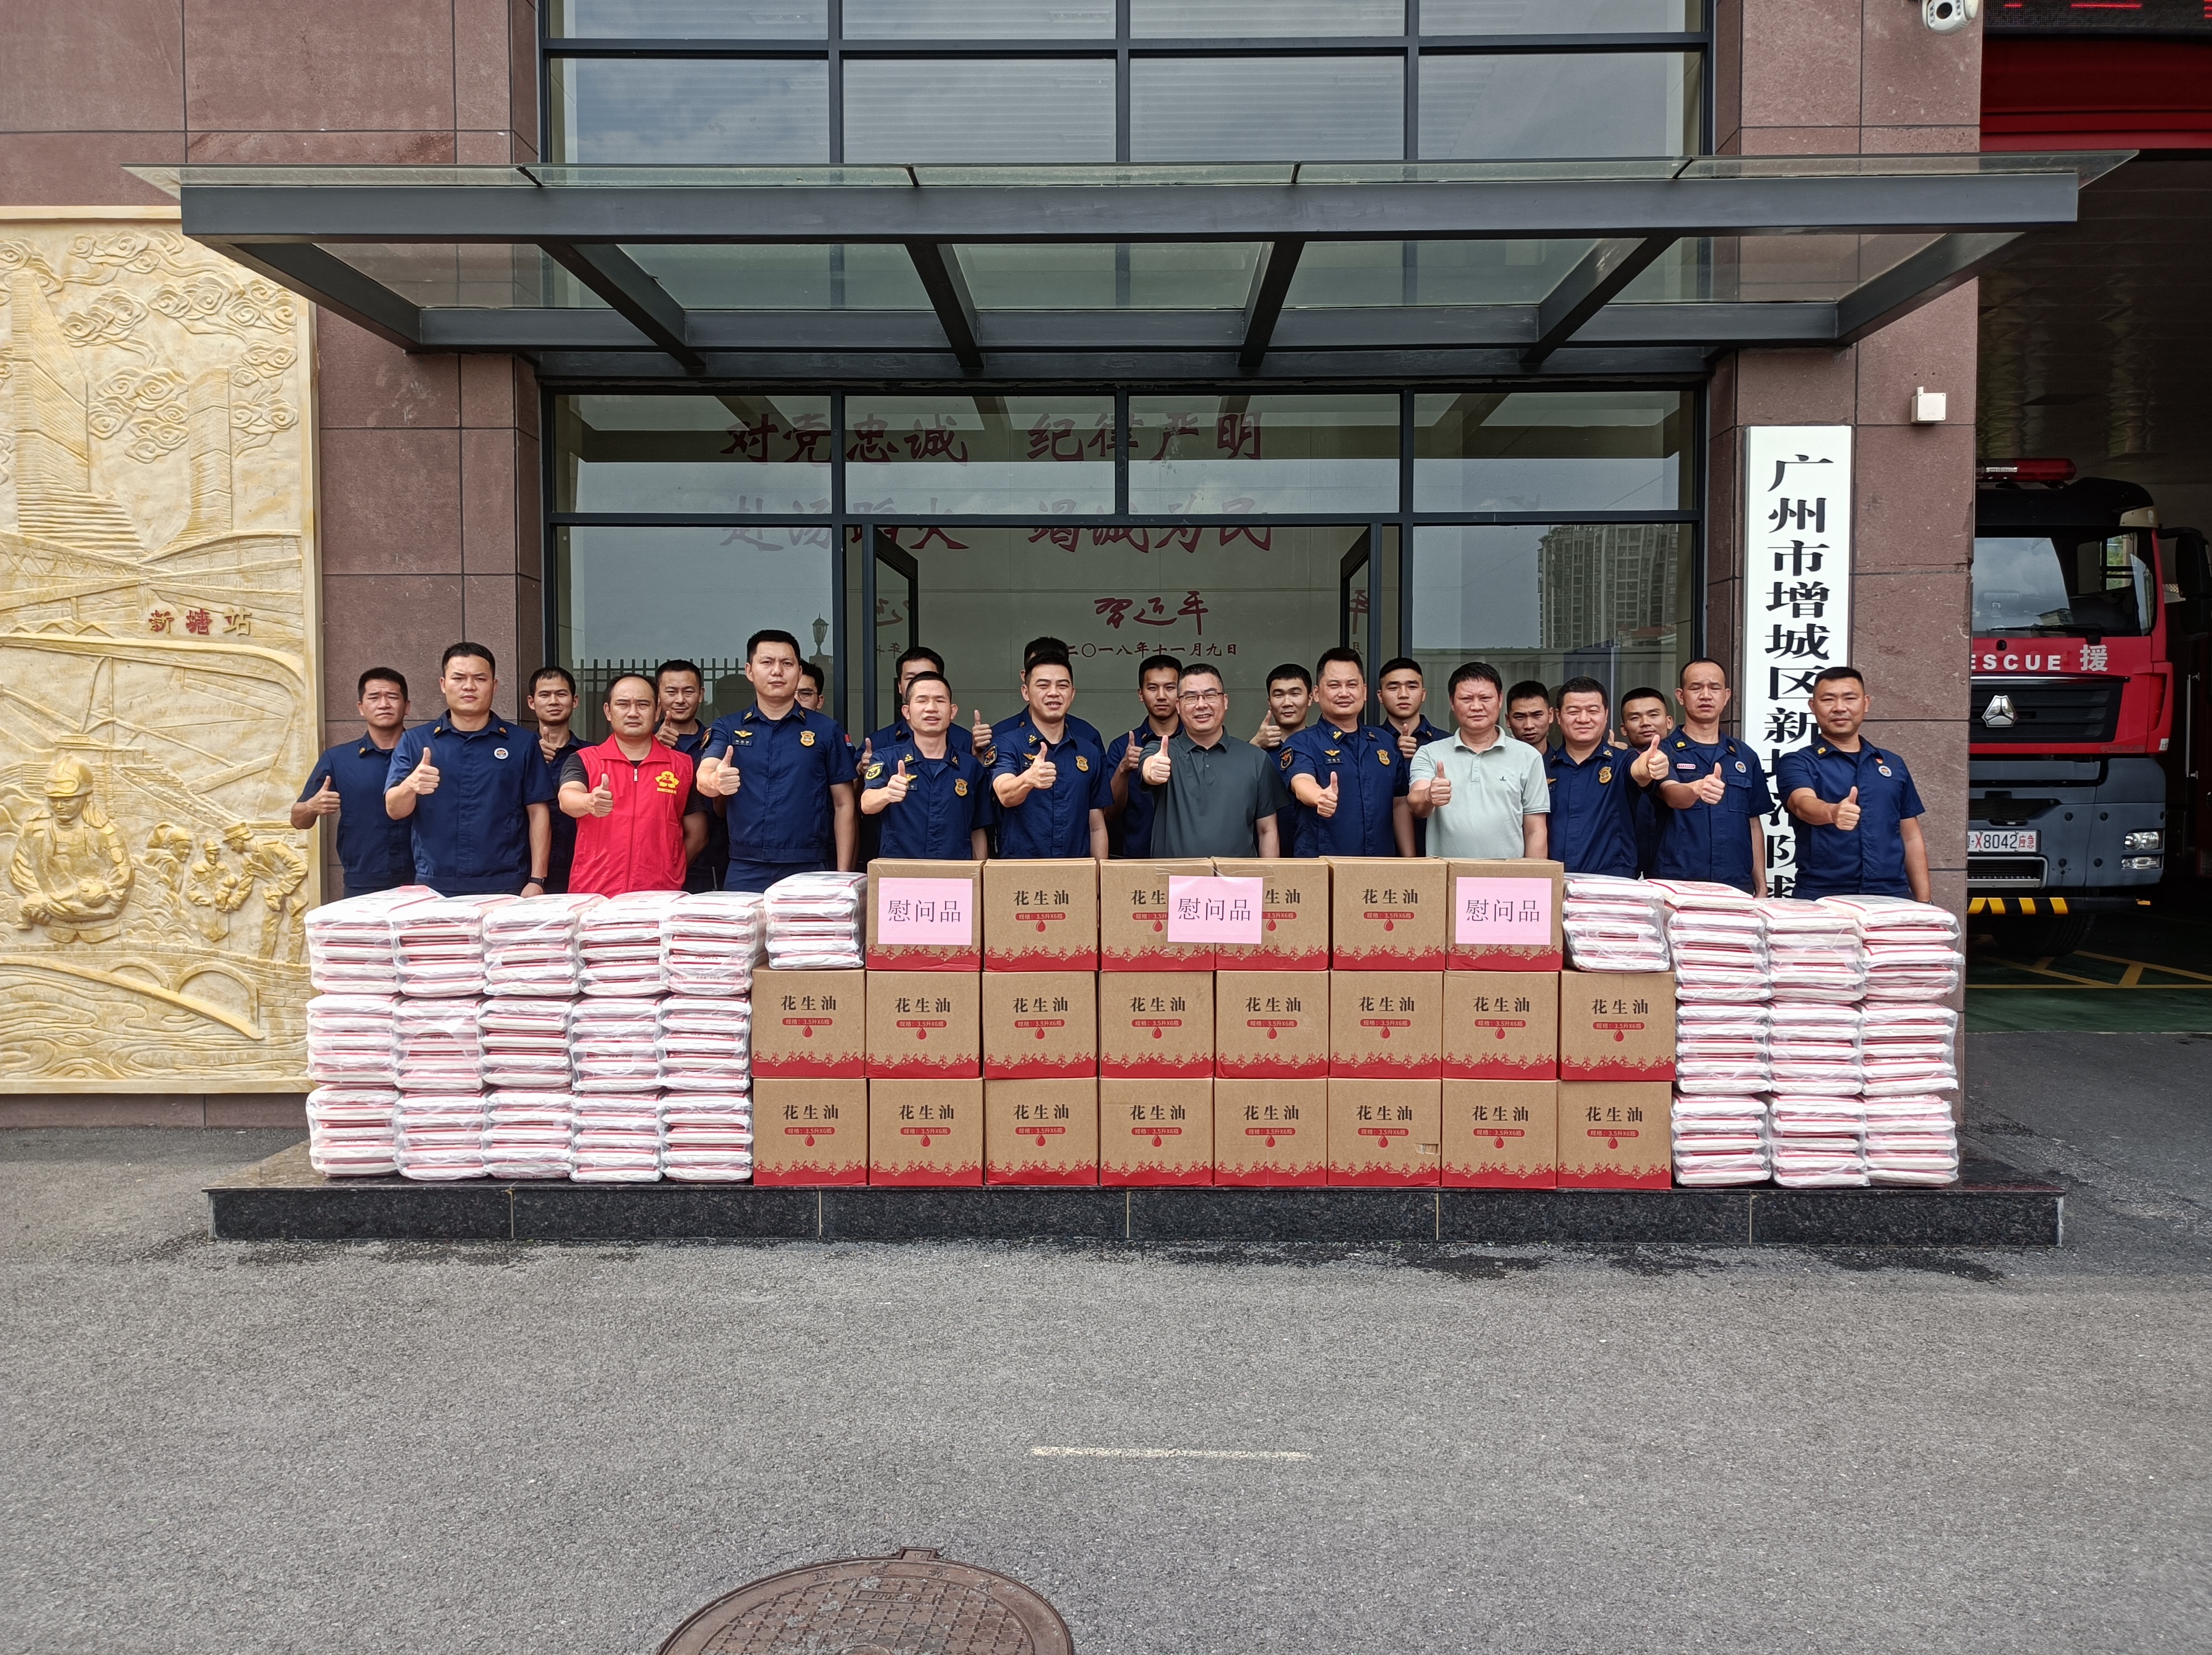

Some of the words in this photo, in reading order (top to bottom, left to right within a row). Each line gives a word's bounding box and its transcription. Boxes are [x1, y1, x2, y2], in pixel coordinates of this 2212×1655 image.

[720, 413, 968, 466] 对党忠诚
[1027, 412, 1262, 464] 纪律严明
[149, 606, 252, 636] 新塘站
[2080, 644, 2107, 672] 援
[1762, 454, 1834, 898] 广州市增城区新防
[1014, 889, 1068, 906] 花生油
[1131, 889, 1166, 905] 花生
[1265, 888, 1300, 904] 生油
[1363, 888, 1417, 904] 花生油
[888, 899, 961, 923] 慰问品
[1177, 898, 1251, 921] 慰问品
[1465, 899, 1540, 923] 慰问品
[781, 995, 836, 1011] 花生油
[895, 997, 950, 1013] 花生油
[1013, 997, 1067, 1013] 花生油
[1130, 996, 1185, 1012] 花生油
[1246, 997, 1300, 1012] 花生油
[1359, 996, 1414, 1012] 花生油
[1474, 996, 1529, 1012] 花生油
[1592, 999, 1647, 1014] 花生油
[783, 1104, 838, 1120] 花生油
[899, 1104, 953, 1120] 花生油
[1014, 1104, 1068, 1120] 花生油
[1130, 1105, 1185, 1120] 花生油
[1244, 1105, 1298, 1121] 花生油
[1357, 1105, 1412, 1121] 花生油
[1473, 1105, 1528, 1122] 花生油
[1586, 1106, 1642, 1122] 花生油
